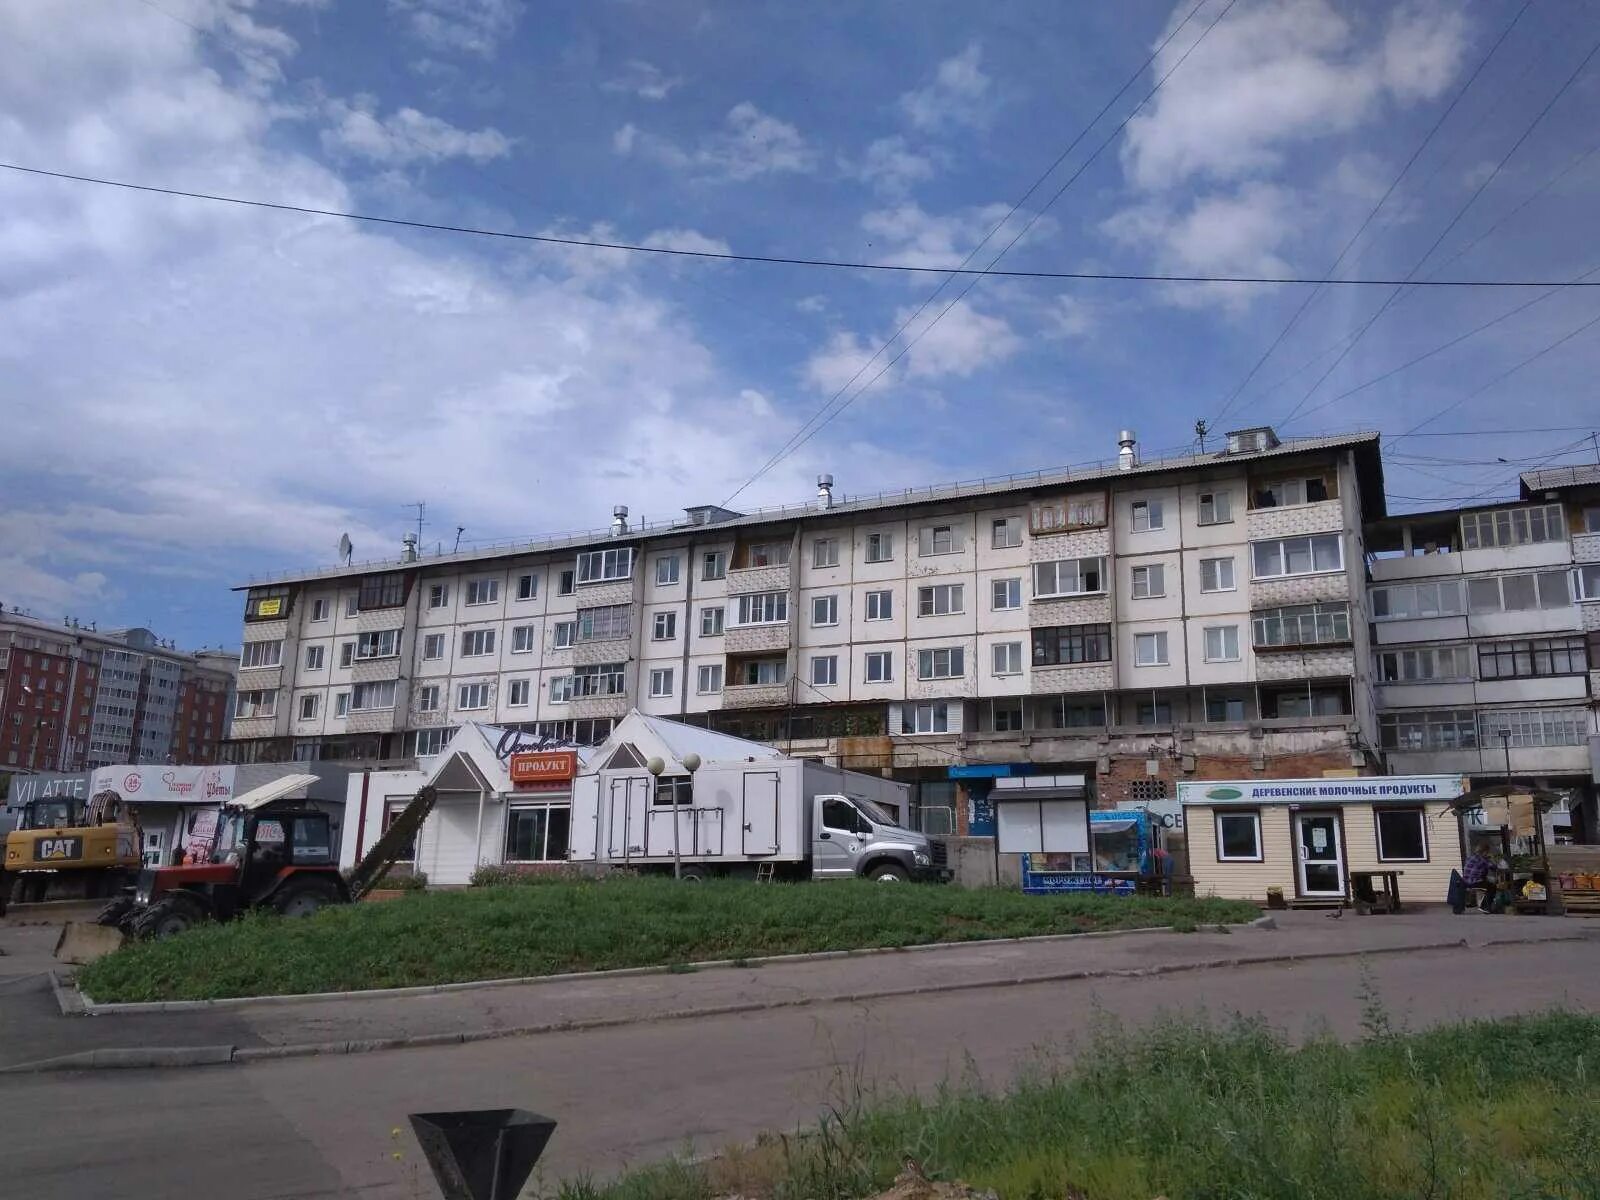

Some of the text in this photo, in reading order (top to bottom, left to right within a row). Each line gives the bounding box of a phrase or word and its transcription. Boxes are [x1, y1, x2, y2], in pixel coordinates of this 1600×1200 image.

[518, 760, 567, 772] ПРОДУКТ
[1252, 786, 1317, 798] ДЕРЕВЕНСКИЕ
[1319, 785, 1377, 796] МОЛОЧНЫЕ
[1379, 783, 1437, 795] ПРОДУКТЫ
[41, 839, 75, 858] CAT
